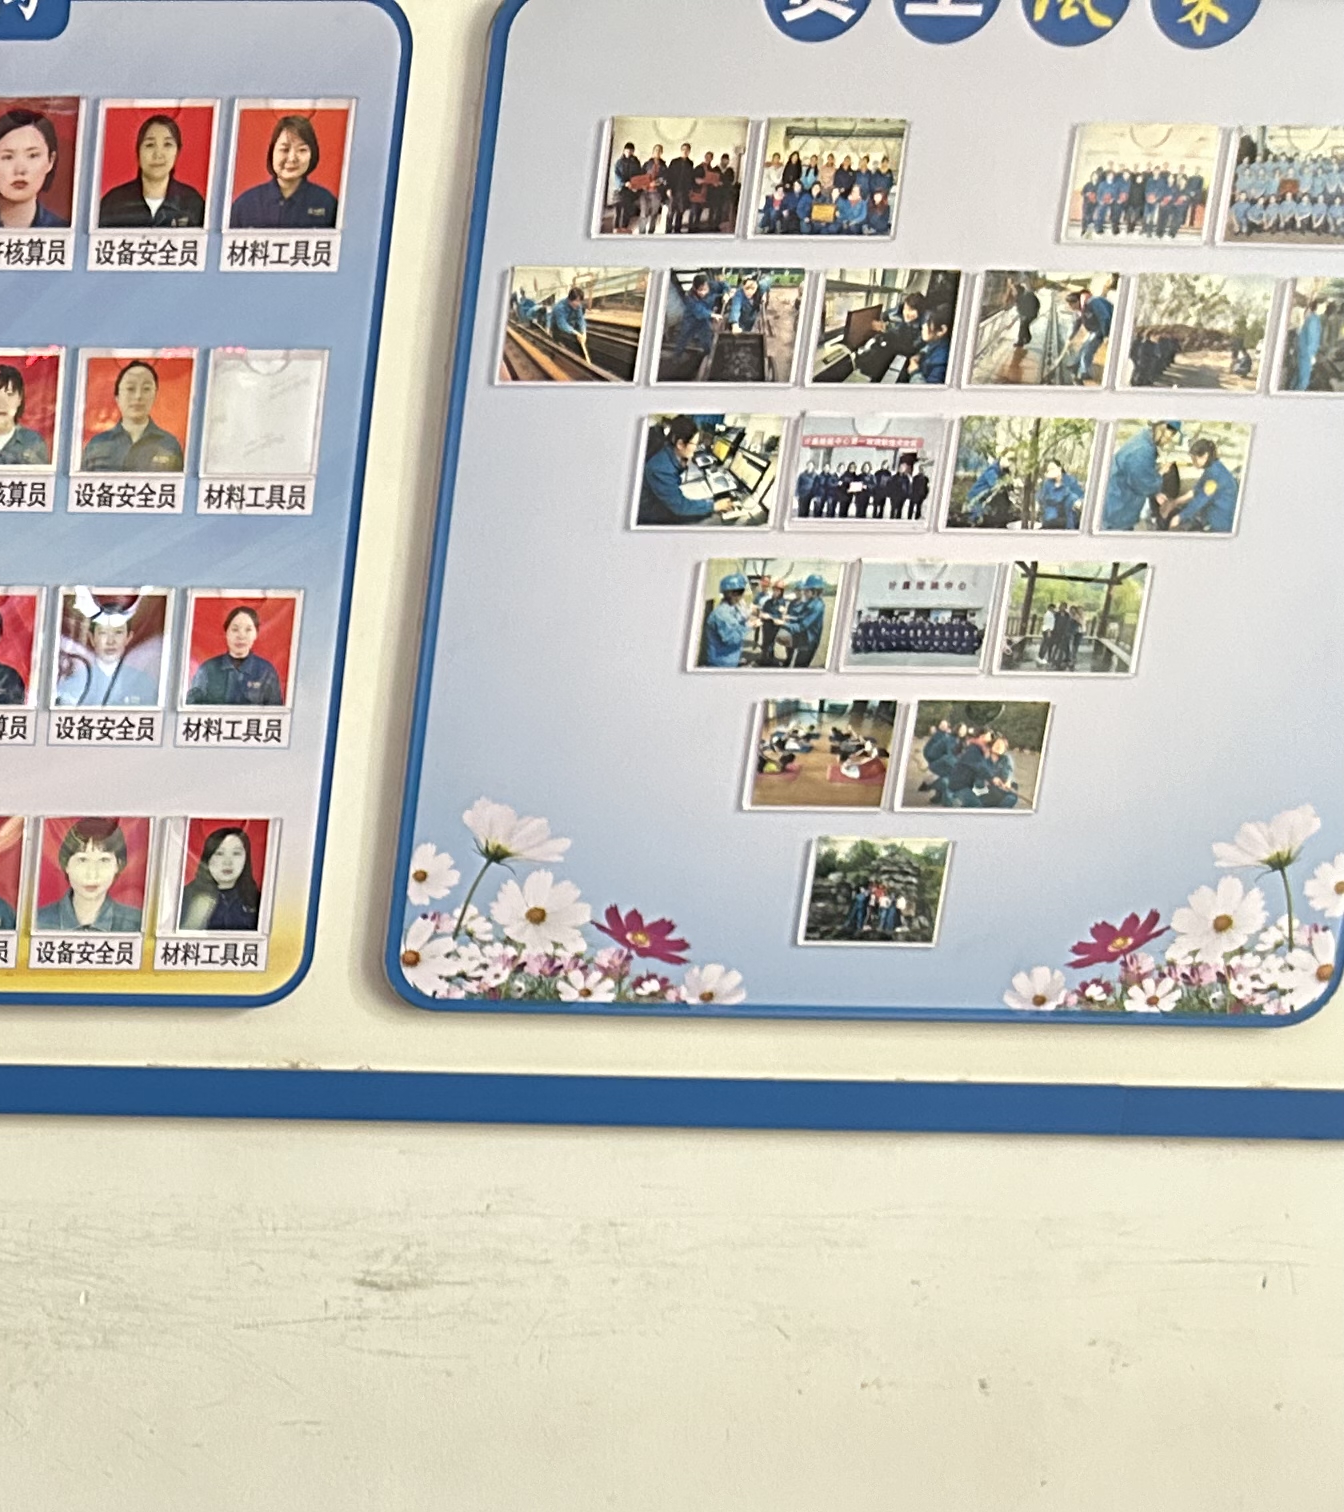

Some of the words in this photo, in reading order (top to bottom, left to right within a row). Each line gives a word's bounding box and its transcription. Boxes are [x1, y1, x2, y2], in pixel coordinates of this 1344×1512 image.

[94, 239, 199, 266] 设备安全员
[228, 240, 332, 266] 材料工具员
[74, 483, 176, 508] 设备安全员
[205, 485, 306, 510] 材料工具员
[55, 716, 155, 741] 设备安全员
[182, 718, 283, 743] 材料工具员
[35, 941, 134, 965] 设备安全员
[161, 943, 259, 967] 材料工具员
